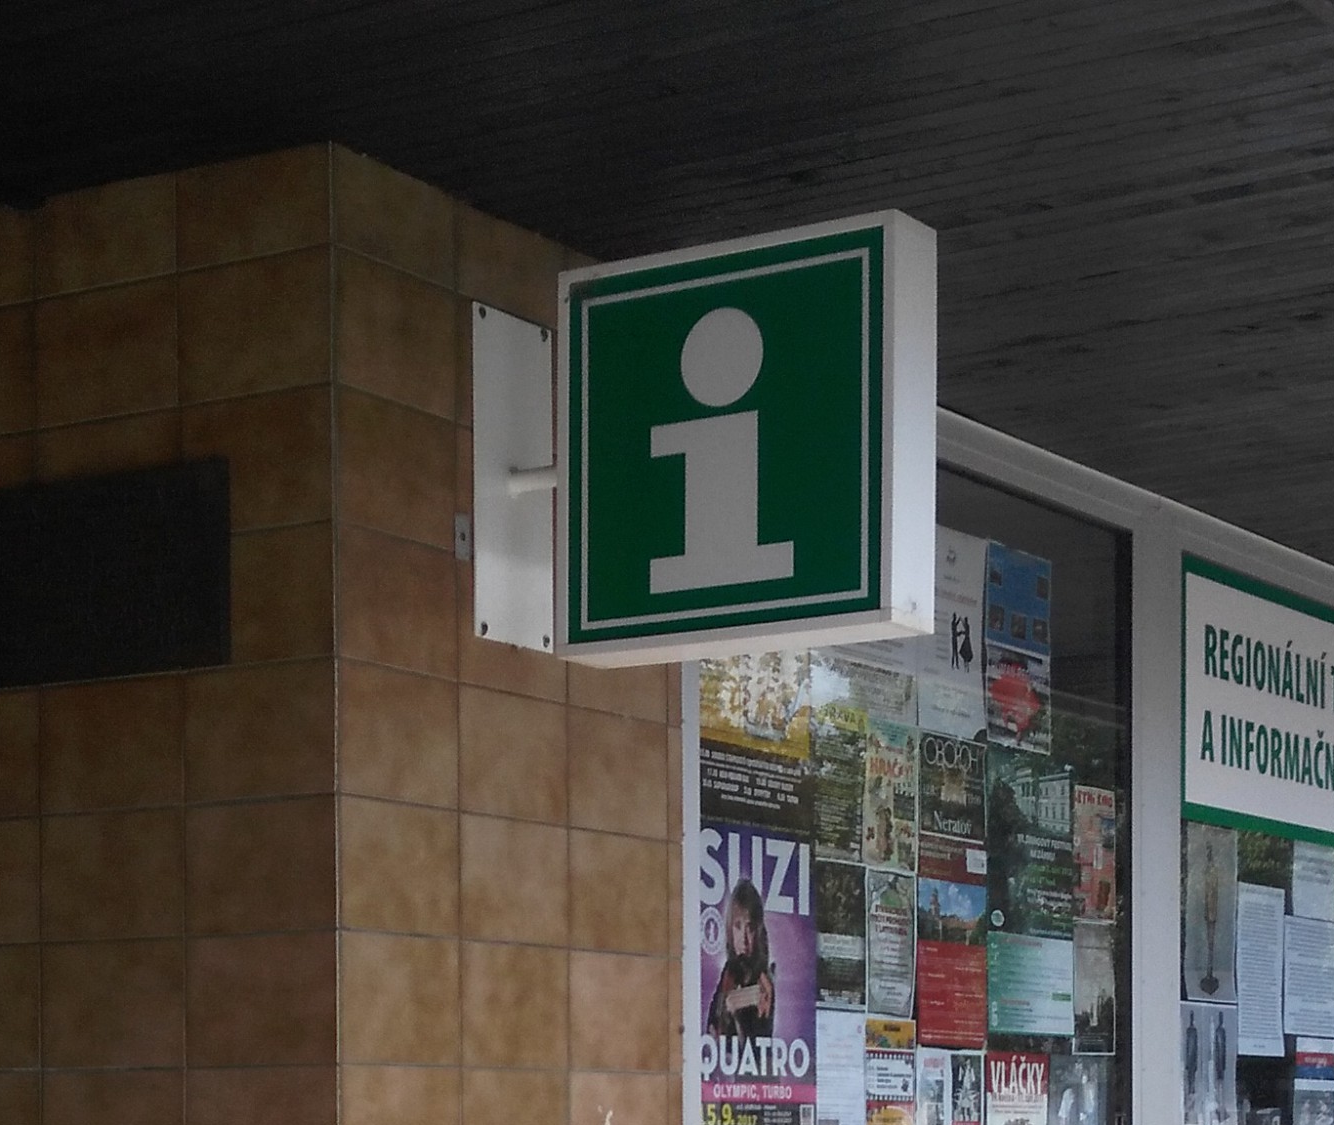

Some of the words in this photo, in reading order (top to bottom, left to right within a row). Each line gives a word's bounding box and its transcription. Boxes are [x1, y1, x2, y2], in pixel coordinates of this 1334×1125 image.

[1204, 624, 1327, 710] REGIONÁLNÍ
[1201, 710, 1215, 763] A
[934, 810, 973, 837] Neratov
[700, 827, 811, 917] SUZI
[700, 1036, 811, 1082] QUATRO
[990, 1055, 1045, 1096] VLÁČKY
[713, 1084, 761, 1102] OLYMPIC,
[763, 1085, 793, 1100] TURBO
